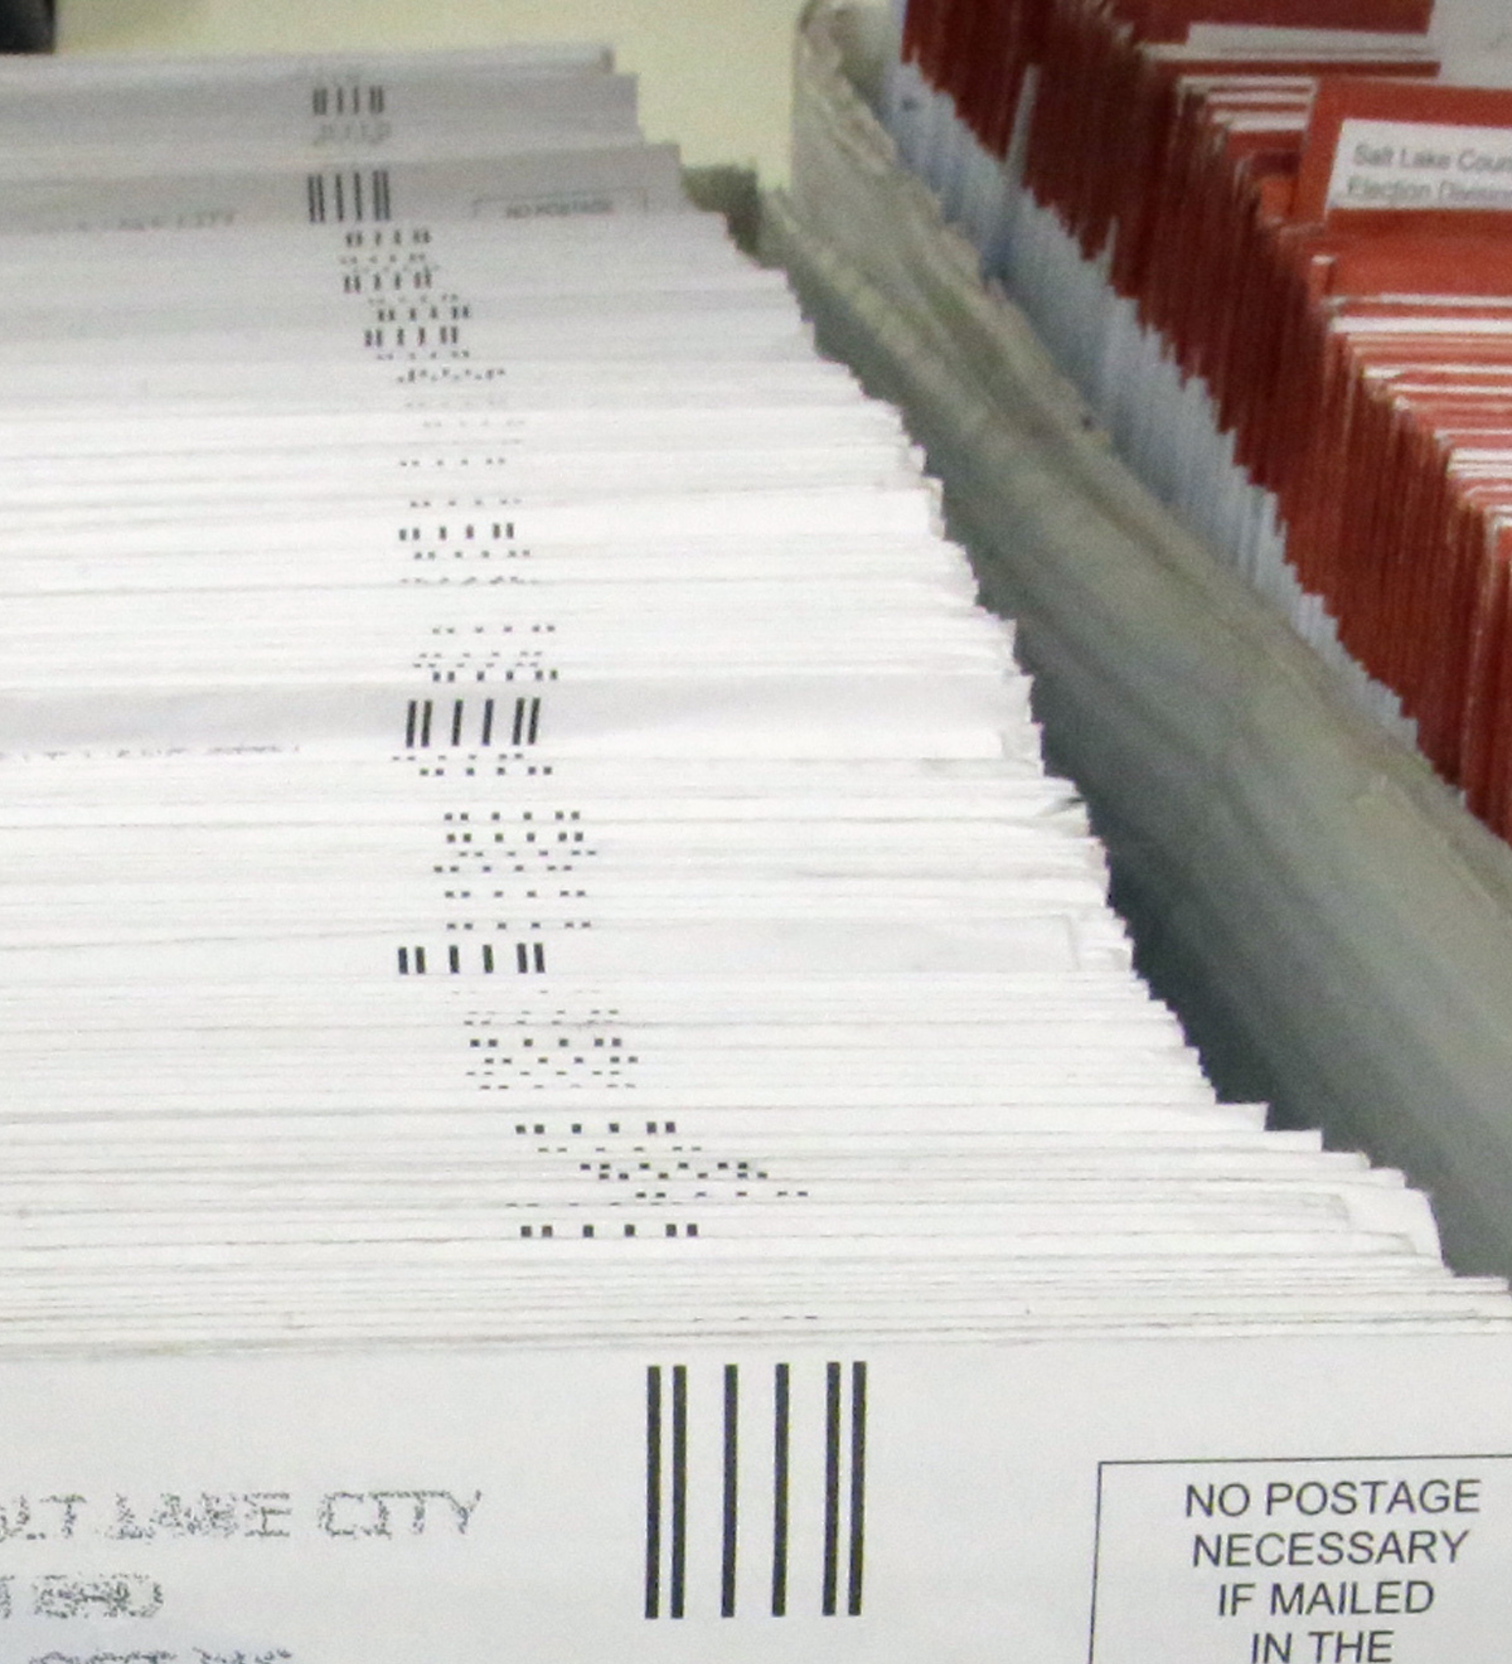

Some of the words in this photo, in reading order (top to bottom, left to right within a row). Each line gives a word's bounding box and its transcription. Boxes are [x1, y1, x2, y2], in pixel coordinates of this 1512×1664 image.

[1355, 145, 1394, 166] Salt
[1401, 148, 1451, 169] Lake
[318, 1489, 481, 1538] CITY
[1185, 1482, 1251, 1518] NO
[1265, 1478, 1481, 1517] POSTAGE
[1192, 1529, 1470, 1568] NECESSARY
[1218, 1582, 1256, 1617] IF
[1270, 1579, 1435, 1616] MAILED
[1307, 1629, 1394, 1664] THE
